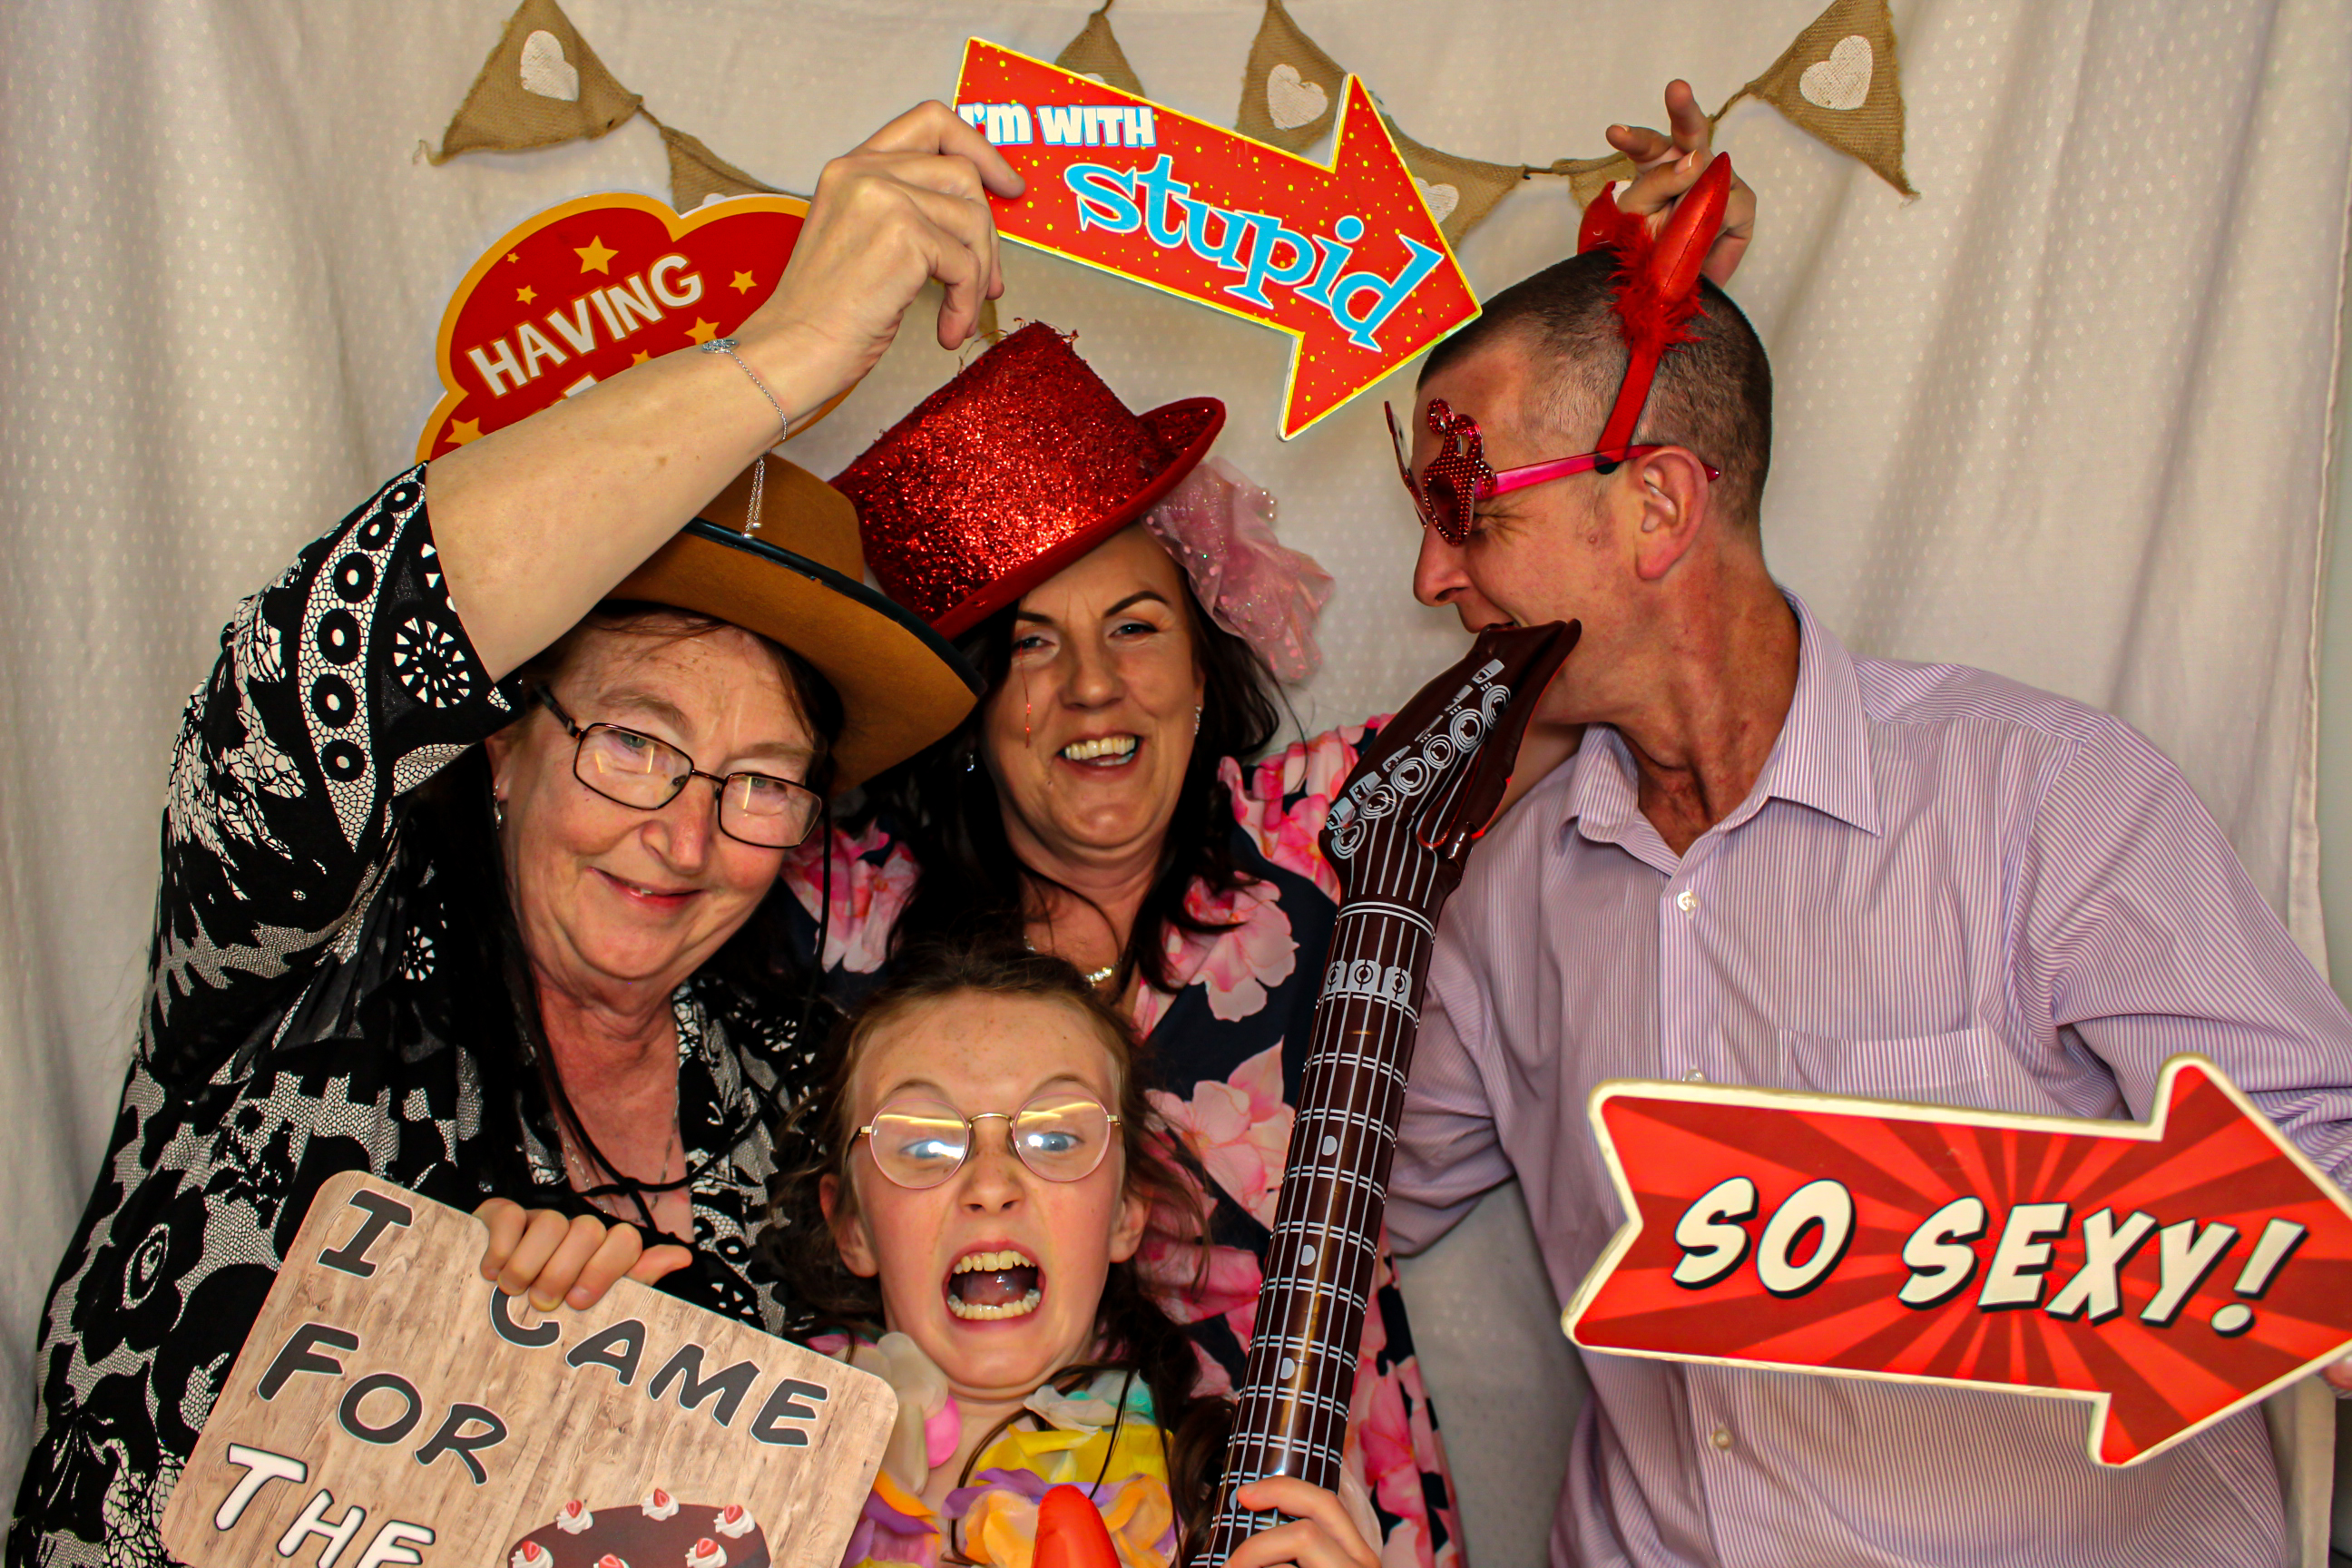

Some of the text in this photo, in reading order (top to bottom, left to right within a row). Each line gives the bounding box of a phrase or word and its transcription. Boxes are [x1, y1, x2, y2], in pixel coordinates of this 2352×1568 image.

[1036, 105, 1155, 146] WITH
[467, 255, 704, 397] HAVING
[1064, 154, 1445, 351] stupid
[318, 1190, 828, 1446] I CAME
[1671, 1177, 2306, 1337] SO SEXY!
[258, 1322, 509, 1485] FOR
[214, 1443, 436, 1568] THE
